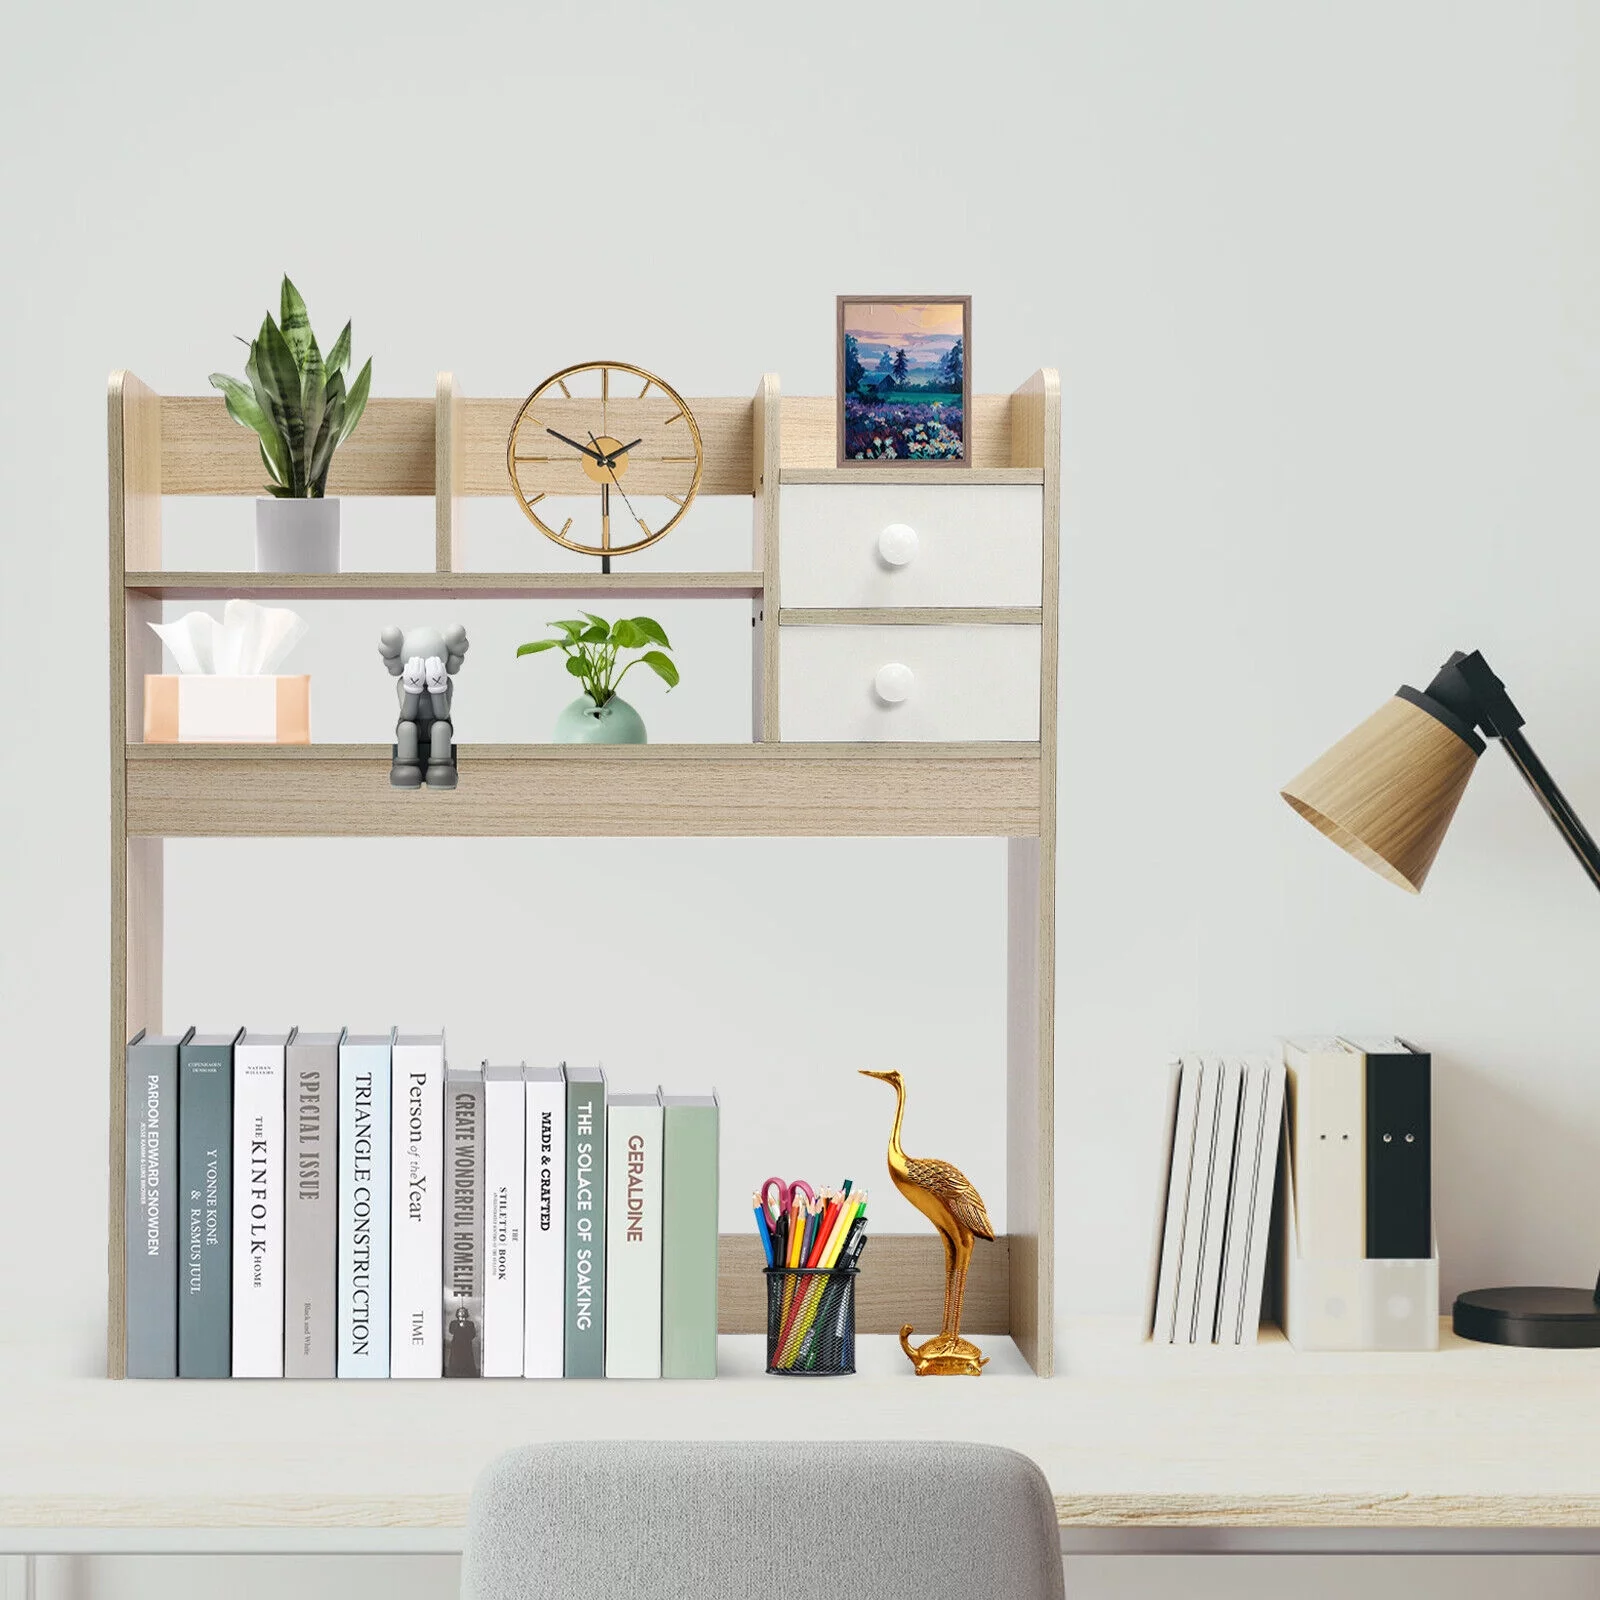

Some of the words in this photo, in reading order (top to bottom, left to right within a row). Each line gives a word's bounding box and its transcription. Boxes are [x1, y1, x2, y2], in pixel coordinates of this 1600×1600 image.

[148, 1074, 159, 1128] PARDON
[299, 1072, 320, 1144] SPECIAL
[409, 1072, 426, 1142] Person
[455, 1093, 476, 1141] CREATE
[577, 1101, 592, 1136] THE
[255, 1116, 263, 1138] THE
[354, 1072, 372, 1182] TRIANGLE
[407, 1145, 420, 1156] of
[541, 1111, 552, 1153] MADE
[148, 1132, 159, 1187] EDWARD
[299, 1152, 320, 1200] ISSUE
[409, 1160, 420, 1179] the
[541, 1155, 551, 1166] &
[577, 1142, 592, 1212] SOLACE
[190, 1190, 202, 1200] &
[250, 1140, 267, 1254] KINFOLK
[409, 1176, 426, 1222] Year
[454, 1146, 475, 1227] WONDERFUL
[540, 1168, 551, 1232] CRAFTED
[627, 1135, 644, 1242] GERALDINE
[147, 1190, 159, 1256] SNOWDEN
[190, 1208, 202, 1260] RASMUS
[206, 1209, 219, 1245] KONÉ
[499, 1187, 507, 1242] STILETTO
[577, 1218, 592, 1242] OF
[189, 1262, 201, 1295] JUUL
[253, 1256, 262, 1288] HOME
[352, 1187, 372, 1356] CONSTRUCTION
[453, 1232, 474, 1297] HOMELIFE
[498, 1249, 506, 1280] BOOK
[576, 1249, 592, 1331] SOAKING
[303, 1336, 311, 1356] White
[412, 1310, 424, 1346] TIME
